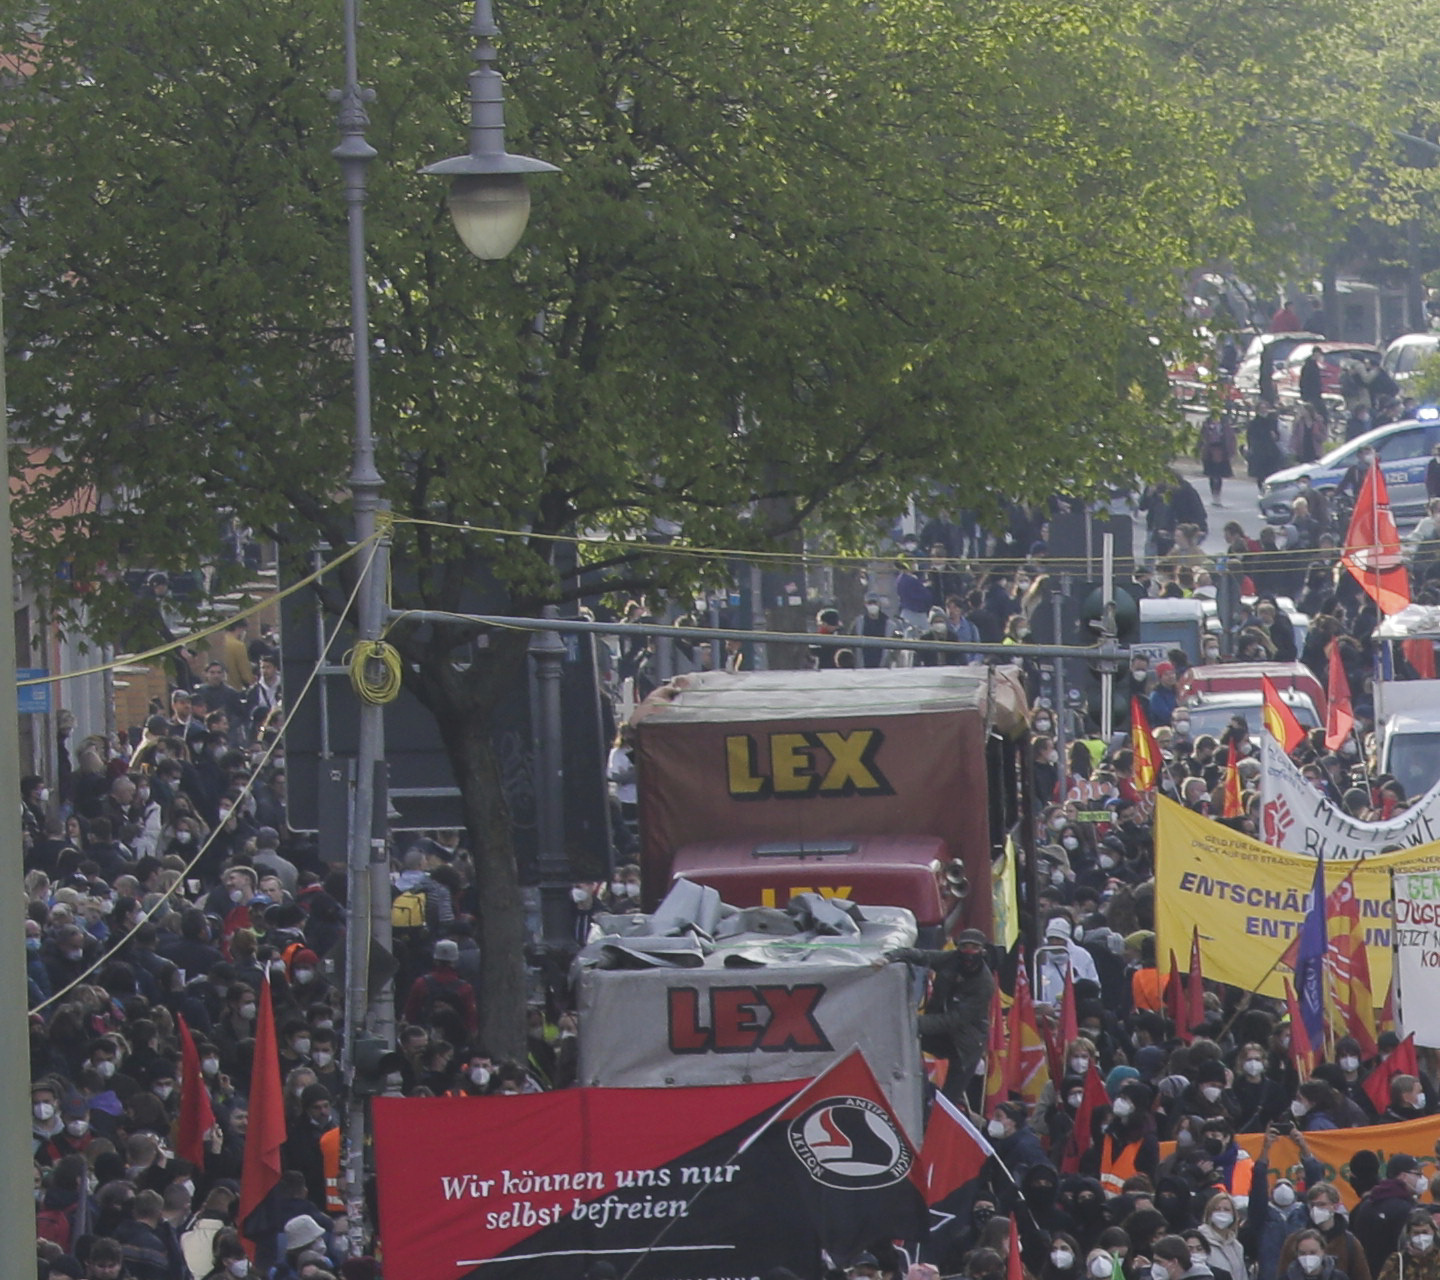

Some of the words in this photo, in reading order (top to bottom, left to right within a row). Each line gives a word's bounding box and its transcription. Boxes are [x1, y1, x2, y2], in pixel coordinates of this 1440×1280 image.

[726, 728, 897, 799] LEX
[667, 983, 836, 1055] LEX
[441, 1174, 495, 1201] Wir
[502, 1167, 606, 1196] können
[614, 1165, 672, 1189] uns
[681, 1161, 742, 1186] nur
[486, 1202, 563, 1231] selbst
[571, 1196, 690, 1229] befreien
